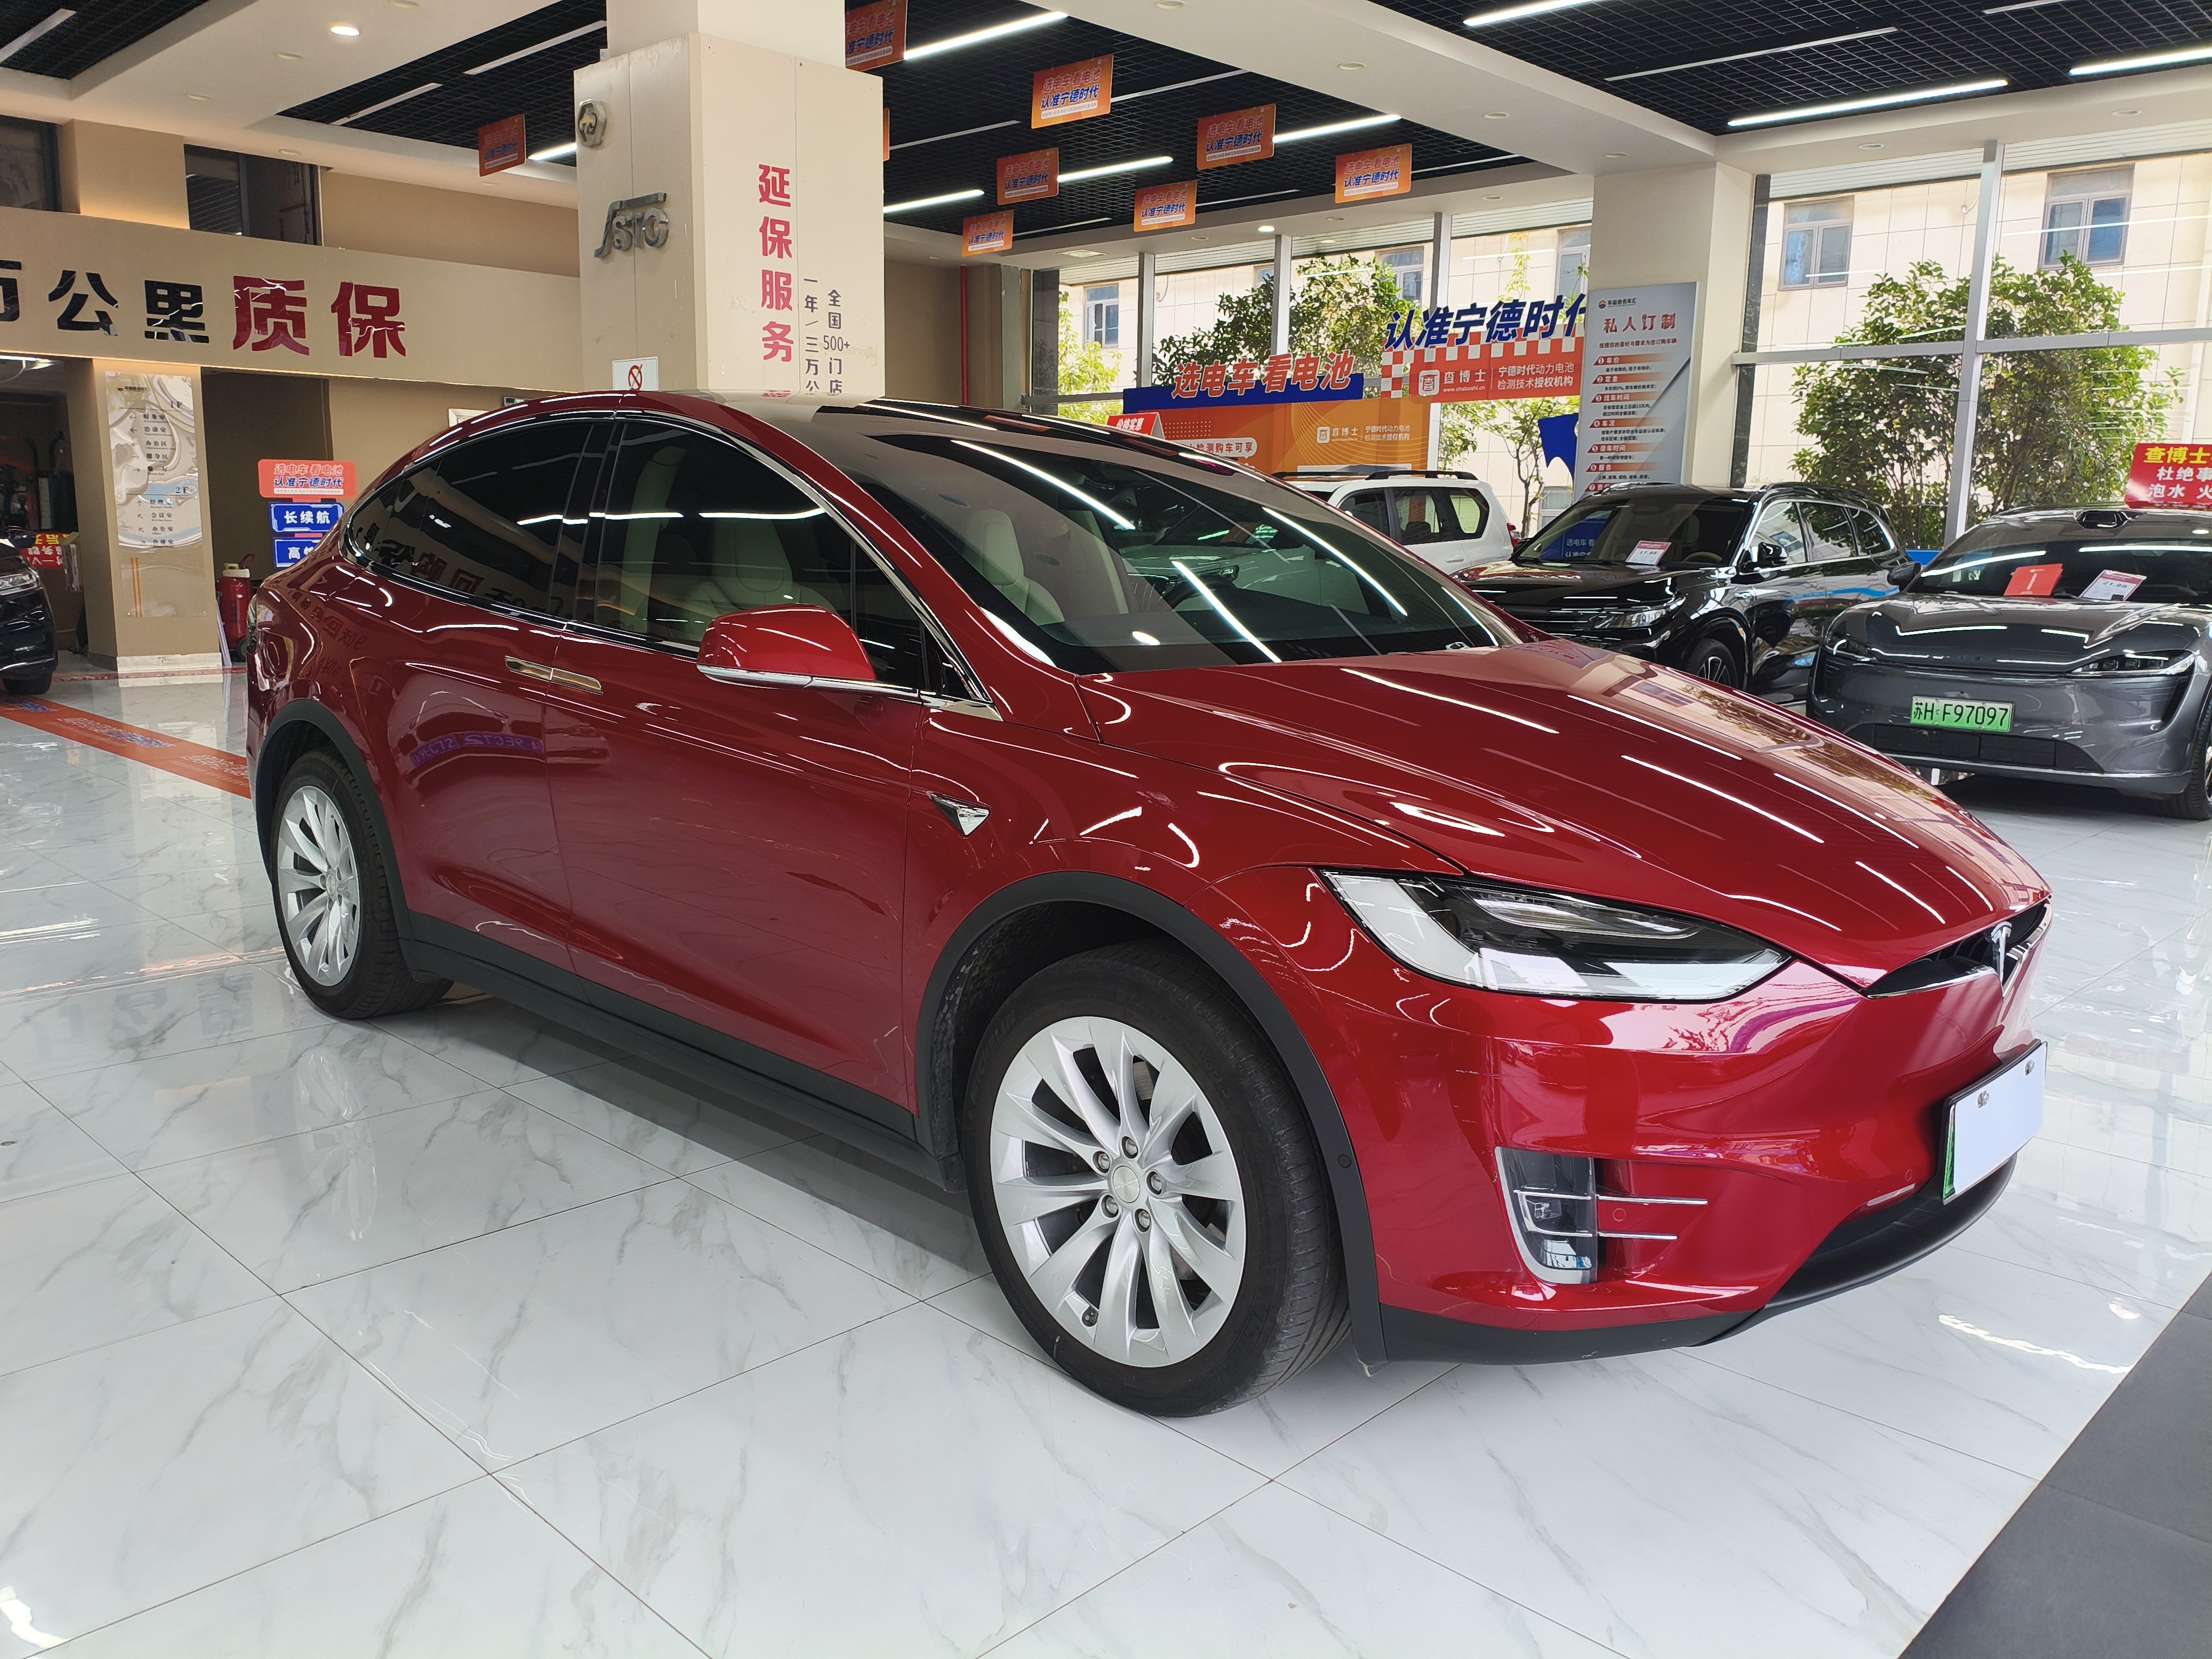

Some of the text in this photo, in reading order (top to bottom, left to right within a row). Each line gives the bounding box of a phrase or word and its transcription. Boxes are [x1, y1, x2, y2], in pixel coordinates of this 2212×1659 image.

[846, 9, 896, 38] 电车看电池
[1042, 66, 1102, 93] 选电车看电池
[1041, 84, 1100, 110] 认准宁德时代
[1206, 113, 1264, 138] 选电车看电池
[1205, 130, 1263, 153] 认准宁德时代
[1345, 154, 1401, 175] 选电车看电池
[1344, 168, 1400, 188] 认准宁德时代
[758, 164, 794, 362] 延保服务
[1603, 313, 1676, 333] 私人订制
[1171, 349, 1355, 399] 选电车看电池
[1444, 369, 1486, 384] 查博士
[1499, 362, 1574, 377] 宁德时代动力电池
[1498, 376, 1573, 390] 检测技术授权机构
[2143, 446, 2212, 464] 查博士
[274, 463, 344, 476] 选电车看电池
[2156, 466, 2212, 482] 杜绝事
[274, 476, 344, 488] 认准宁德时代
[2147, 483, 2186, 498] 泡水
[284, 510, 331, 524] 长续航
